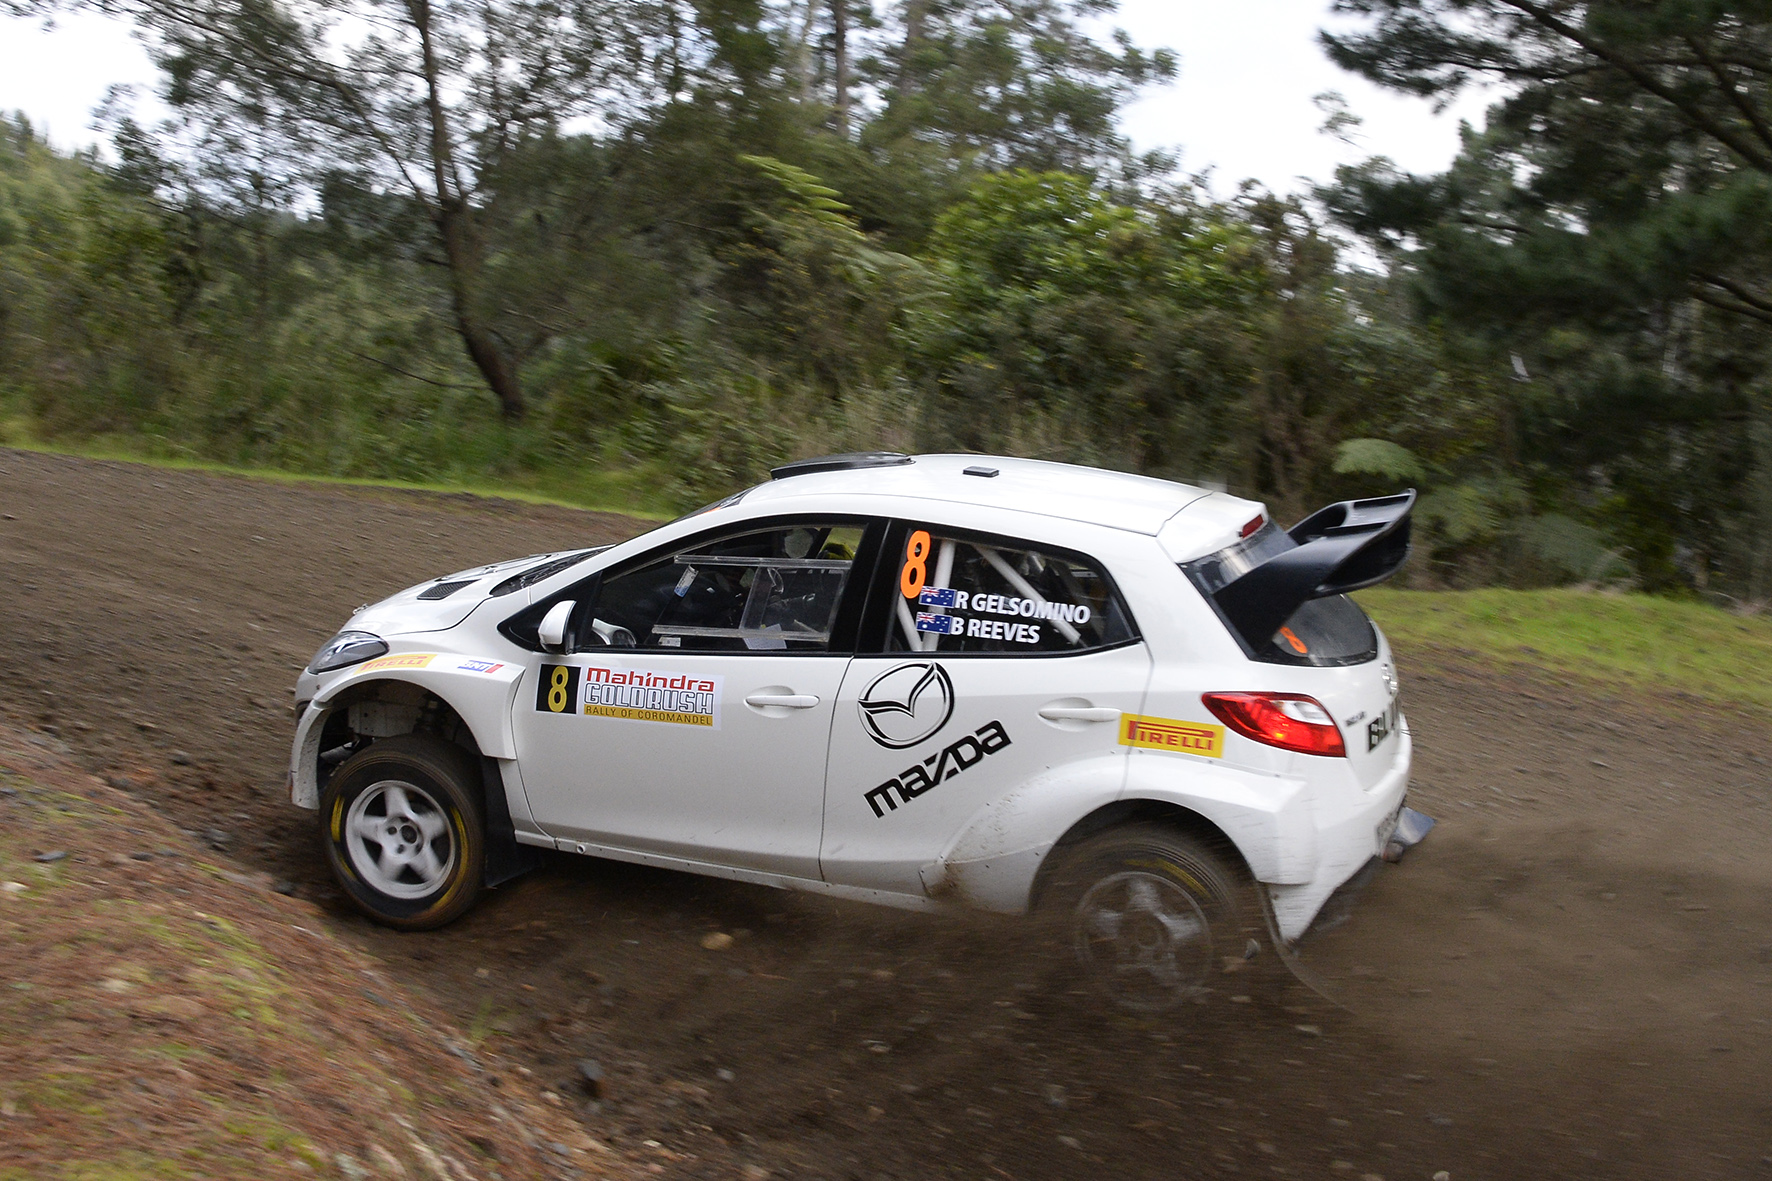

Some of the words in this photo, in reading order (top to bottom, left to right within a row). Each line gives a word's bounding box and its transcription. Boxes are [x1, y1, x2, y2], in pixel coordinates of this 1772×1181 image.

[901, 530, 931, 599] 8
[955, 591, 968, 609] R
[972, 593, 1091, 624] GELSOMINO
[951, 617, 963, 635] B
[968, 619, 1040, 643] REEVES
[361, 656, 428, 671] PIRELLI
[548, 665, 568, 712] 8
[587, 667, 714, 692] Mahindra
[584, 683, 714, 714] GOLDRUSH
[586, 705, 616, 715] RALLY
[621, 709, 633, 717] OF
[638, 711, 711, 725] COROMANDEL
[1128, 720, 1215, 750] PIRELLI
